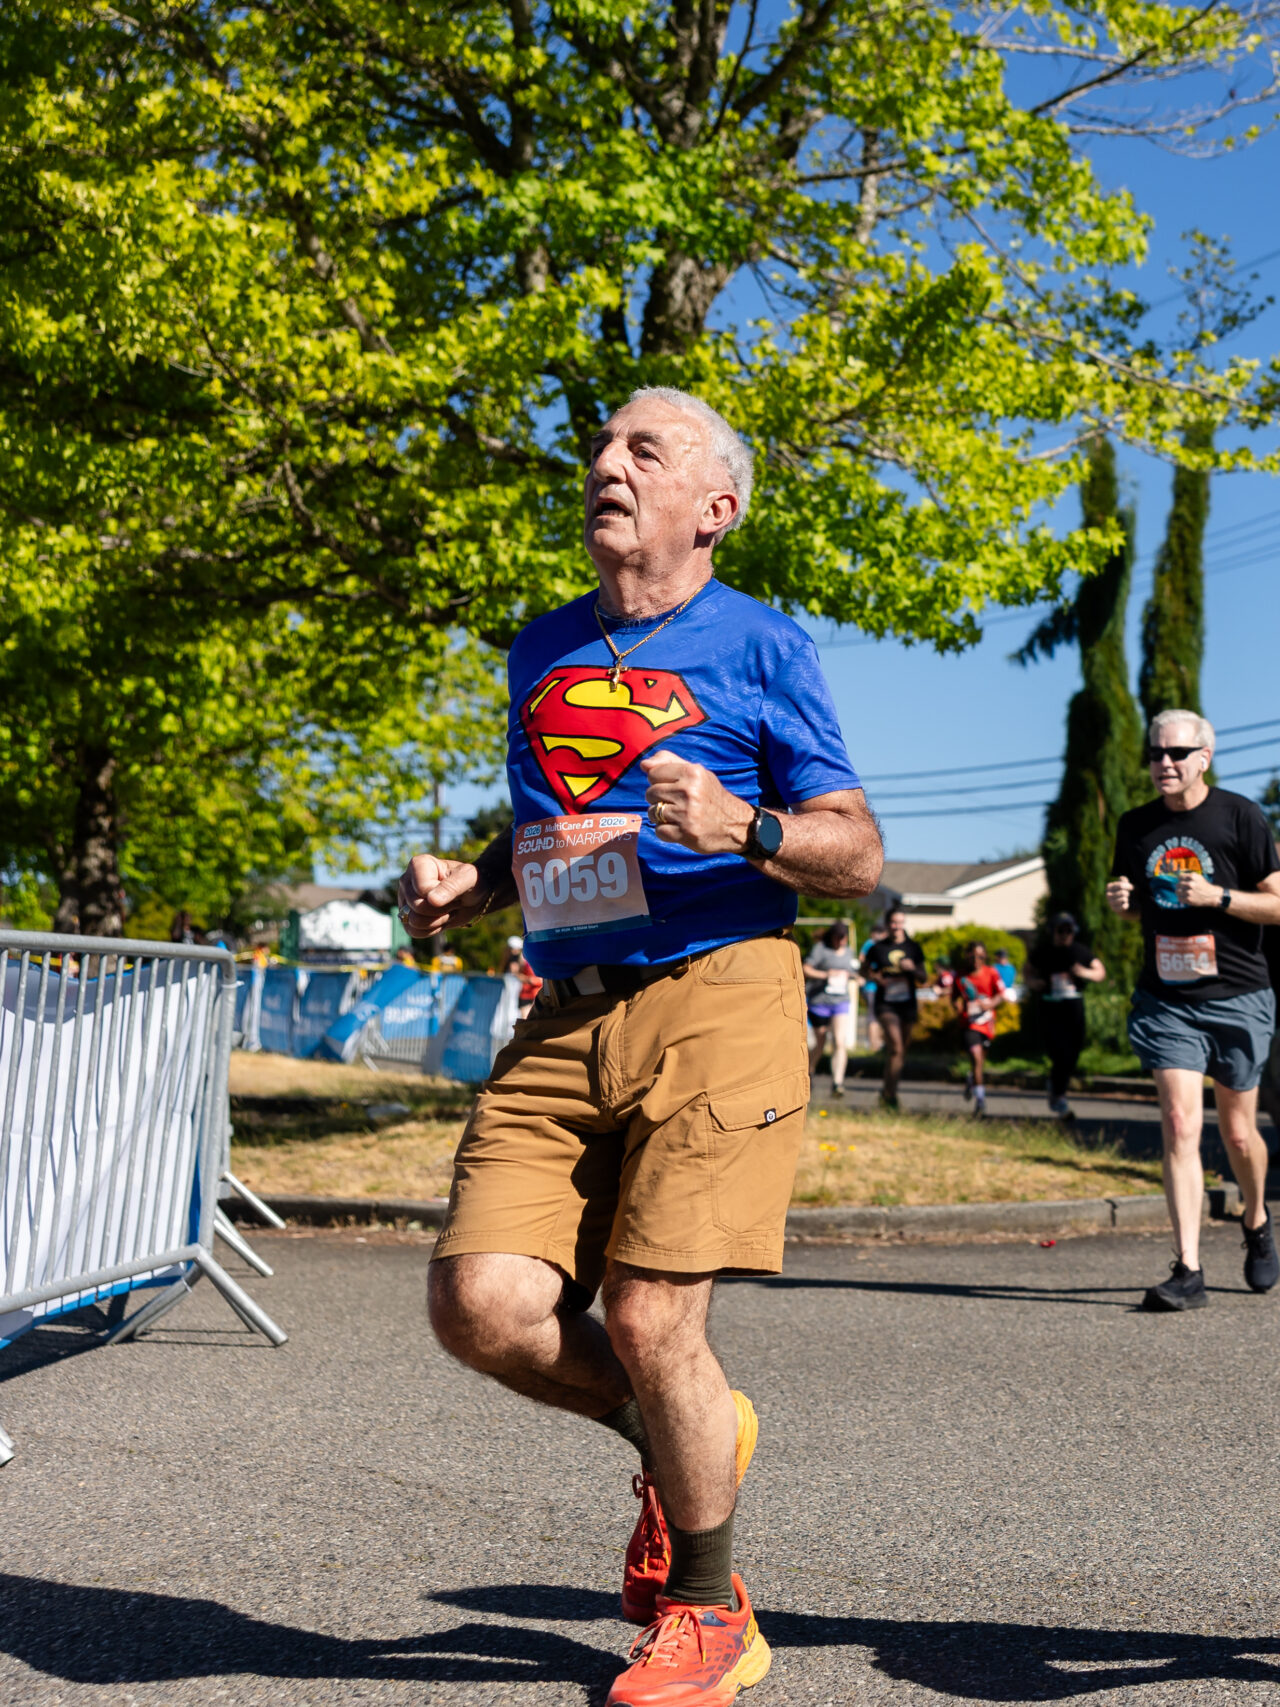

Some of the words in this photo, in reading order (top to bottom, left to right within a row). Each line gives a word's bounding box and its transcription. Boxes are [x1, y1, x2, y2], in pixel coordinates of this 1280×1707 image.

[524, 825, 541, 837] 2026
[545, 821, 581, 833] MultiCare
[600, 817, 625, 828] 2026
[517, 836, 555, 855] SOUND
[555, 840, 566, 849] to
[566, 829, 634, 848] NARROWS
[521, 851, 629, 908] 6059
[1159, 951, 1210, 972] 5654
